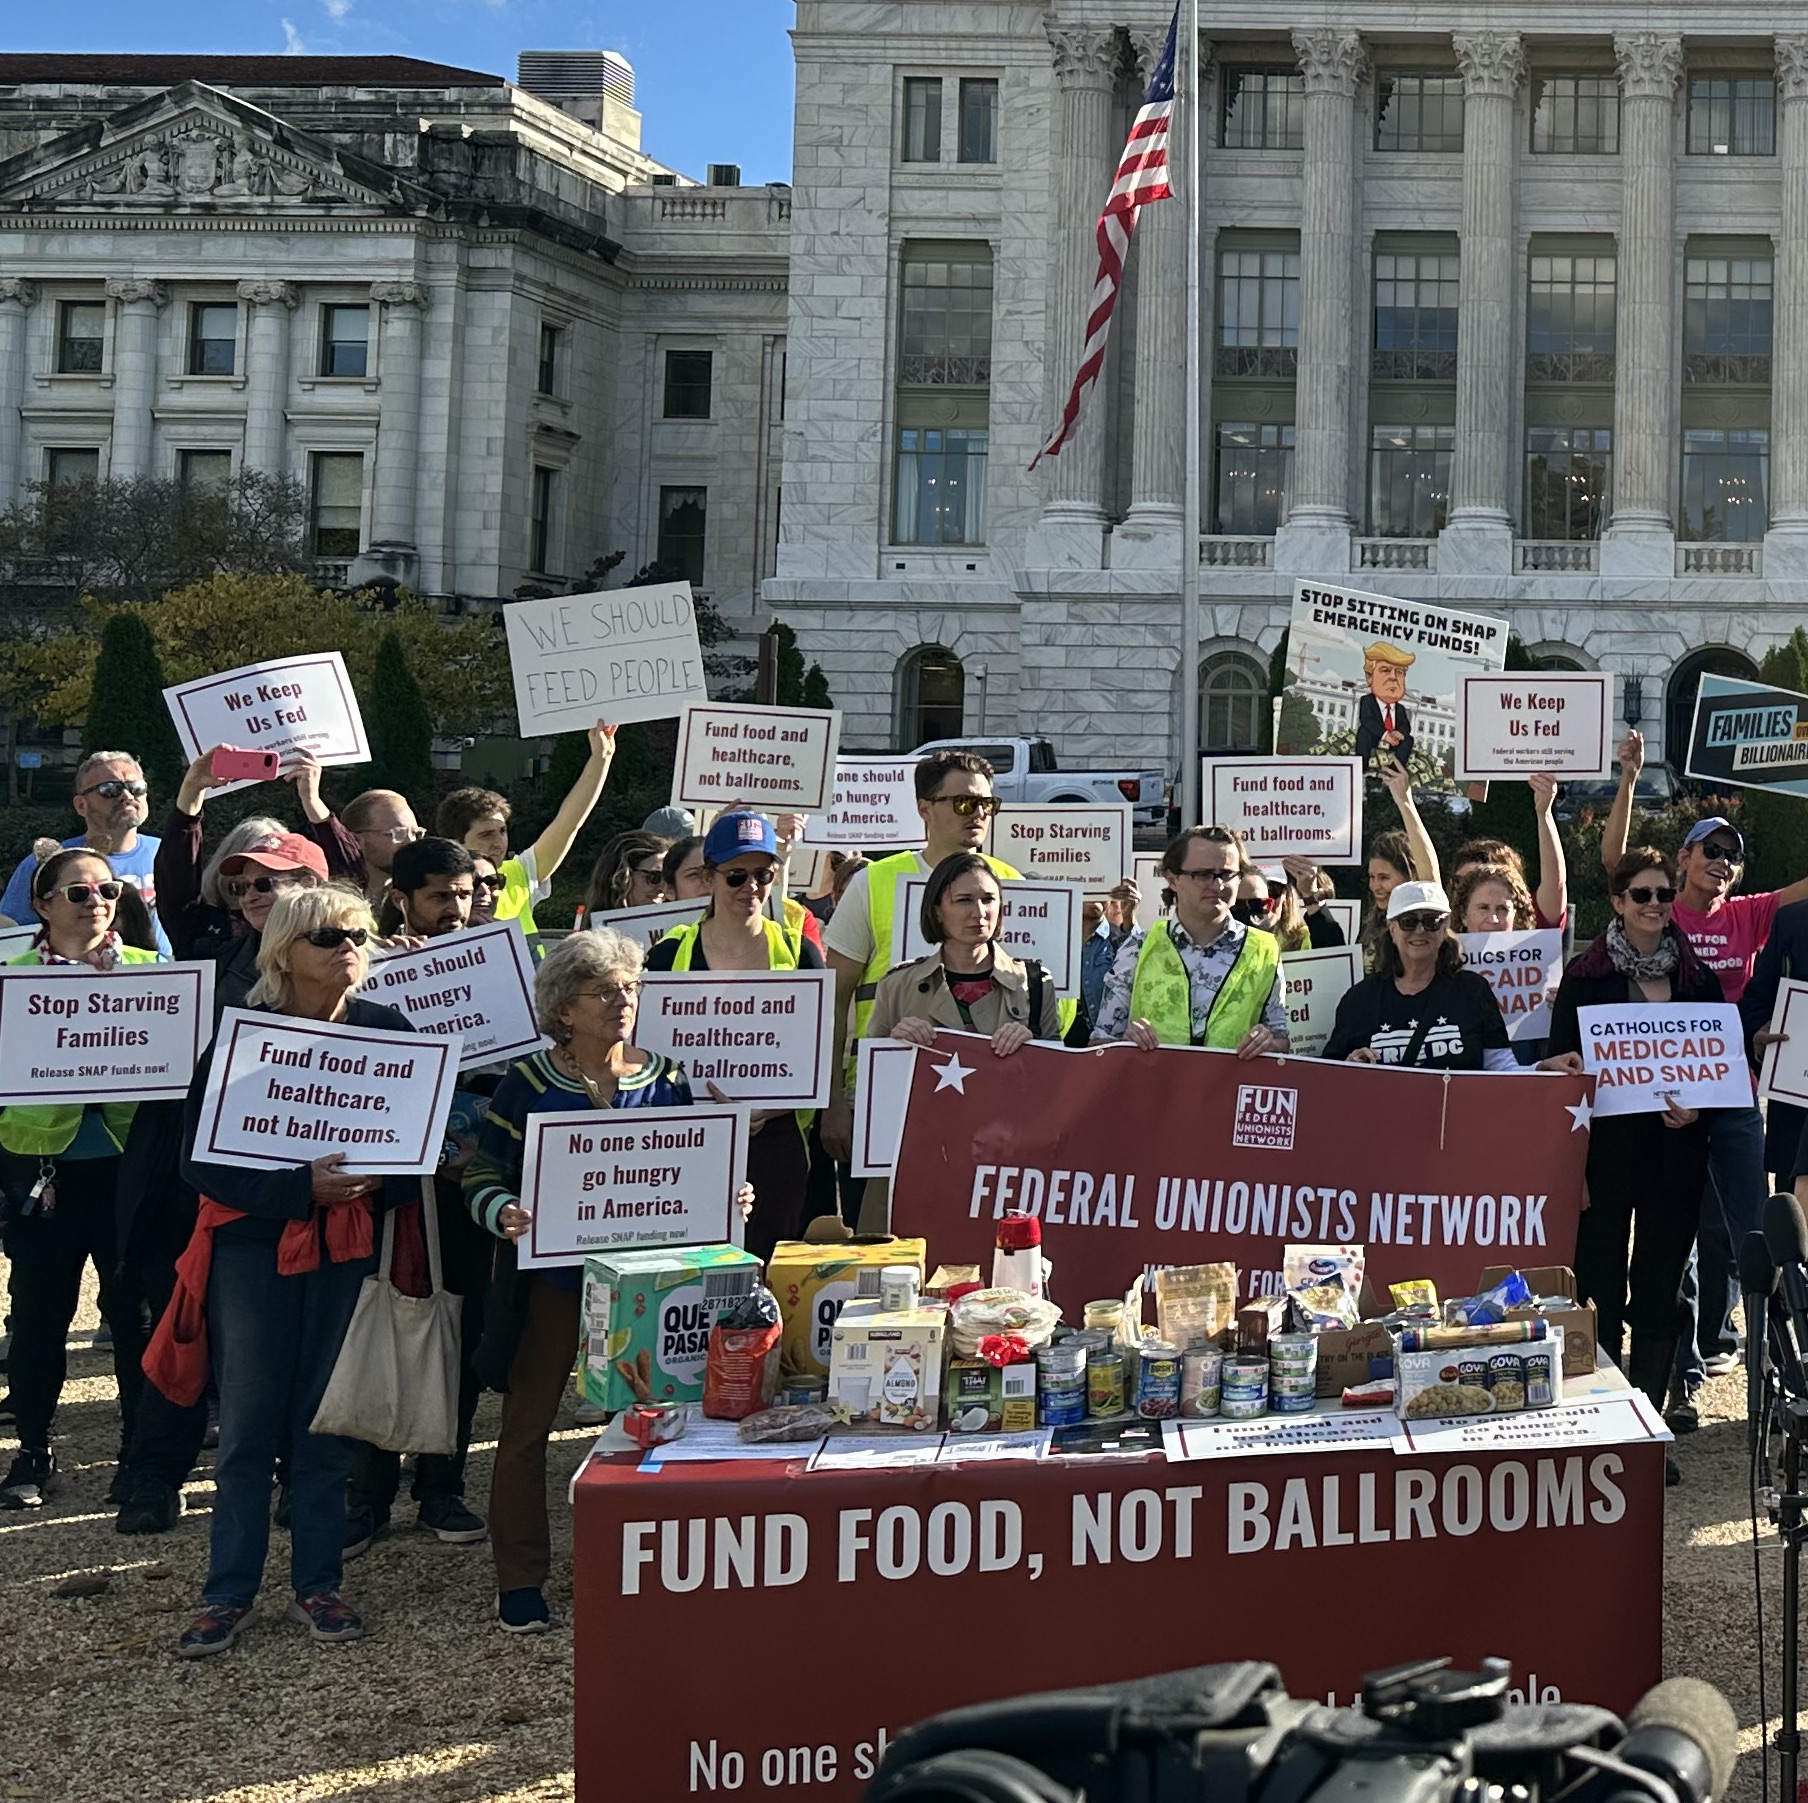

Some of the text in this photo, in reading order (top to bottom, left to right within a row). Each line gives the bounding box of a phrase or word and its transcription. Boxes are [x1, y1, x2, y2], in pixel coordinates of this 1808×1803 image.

[519, 594, 690, 649] WE SHOULD
[1301, 589, 1497, 640] STOP SITTING ON SNAP
[1312, 609, 1480, 656] EMERGENCY FUNDS!
[526, 658, 699, 709] FEED PEOPLE
[224, 682, 302, 712] We Keep
[1500, 692, 1566, 713] We Keep
[246, 706, 308, 734] Us Fed
[1509, 720, 1561, 737] Us Fed
[1711, 709, 1793, 742] FAMILIES
[705, 723, 808, 743] Fund food and
[712, 747, 795, 768] healthcare,
[699, 773, 803, 791] not ballrooms.
[28, 991, 181, 1018] Stop Starving
[662, 994, 795, 1015] Fund food and
[56, 1026, 149, 1048] Families
[672, 1028, 781, 1048] healthcare,
[1590, 1018, 1723, 1036] CATHOLICS FOR
[260, 1042, 414, 1079] Fund food and
[1593, 1038, 1726, 1061] MEDICAID
[31, 1062, 169, 1078] Release SNAP funds now!
[693, 1060, 793, 1078] ballrooms.
[1598, 1063, 1730, 1088] AND SNAP
[267, 1078, 391, 1114] healthcare,
[1240, 1089, 1294, 1115] FUN
[242, 1114, 400, 1144] not ballrooms.
[1238, 1123, 1291, 1135] UNIONISTS
[1239, 1112, 1292, 1124] FEDERAL
[570, 1127, 705, 1154] No one should
[1237, 1134, 1290, 1145] NETWORK
[583, 1164, 681, 1191] go hungry
[577, 1197, 688, 1221] in America.
[969, 1165, 1548, 1248] FEDERAL UNIONISTS NETWORK
[576, 1227, 688, 1246] Release SNAP funding now!
[664, 1305, 710, 1333] QUE
[663, 1331, 709, 1356] PASA
[1489, 1355, 1521, 1368] GOYA
[622, 1454, 1627, 1597] FUND FOOD, NOT BALLROOMS
